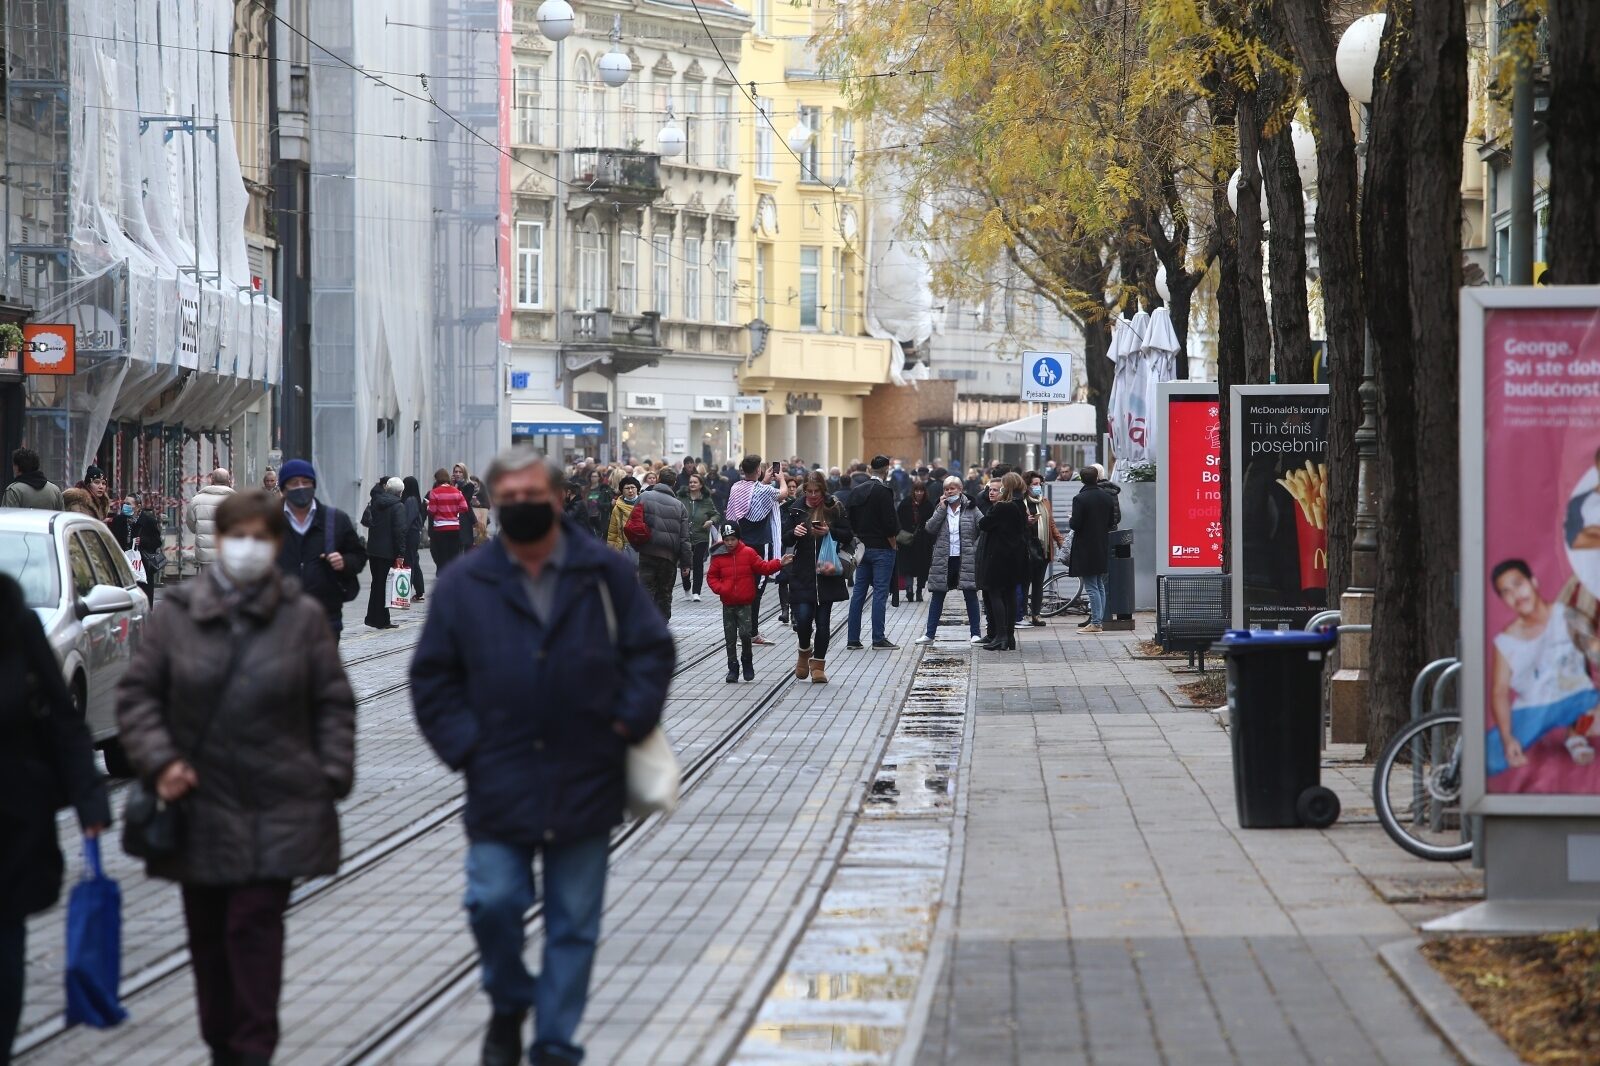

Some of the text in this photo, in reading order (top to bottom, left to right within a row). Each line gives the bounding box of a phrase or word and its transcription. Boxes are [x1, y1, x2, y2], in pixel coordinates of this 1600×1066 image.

[1504, 338, 1574, 357] George.
[1504, 359, 1531, 376] Svi
[1536, 361, 1563, 376] ste
[1026, 390, 1051, 399] Pješačka
[1250, 406, 1299, 414] McDonald's
[1250, 421, 1312, 435] Ti ih činiš
[1202, 471, 1220, 482] Bo
[1196, 488, 1221, 500] i no
